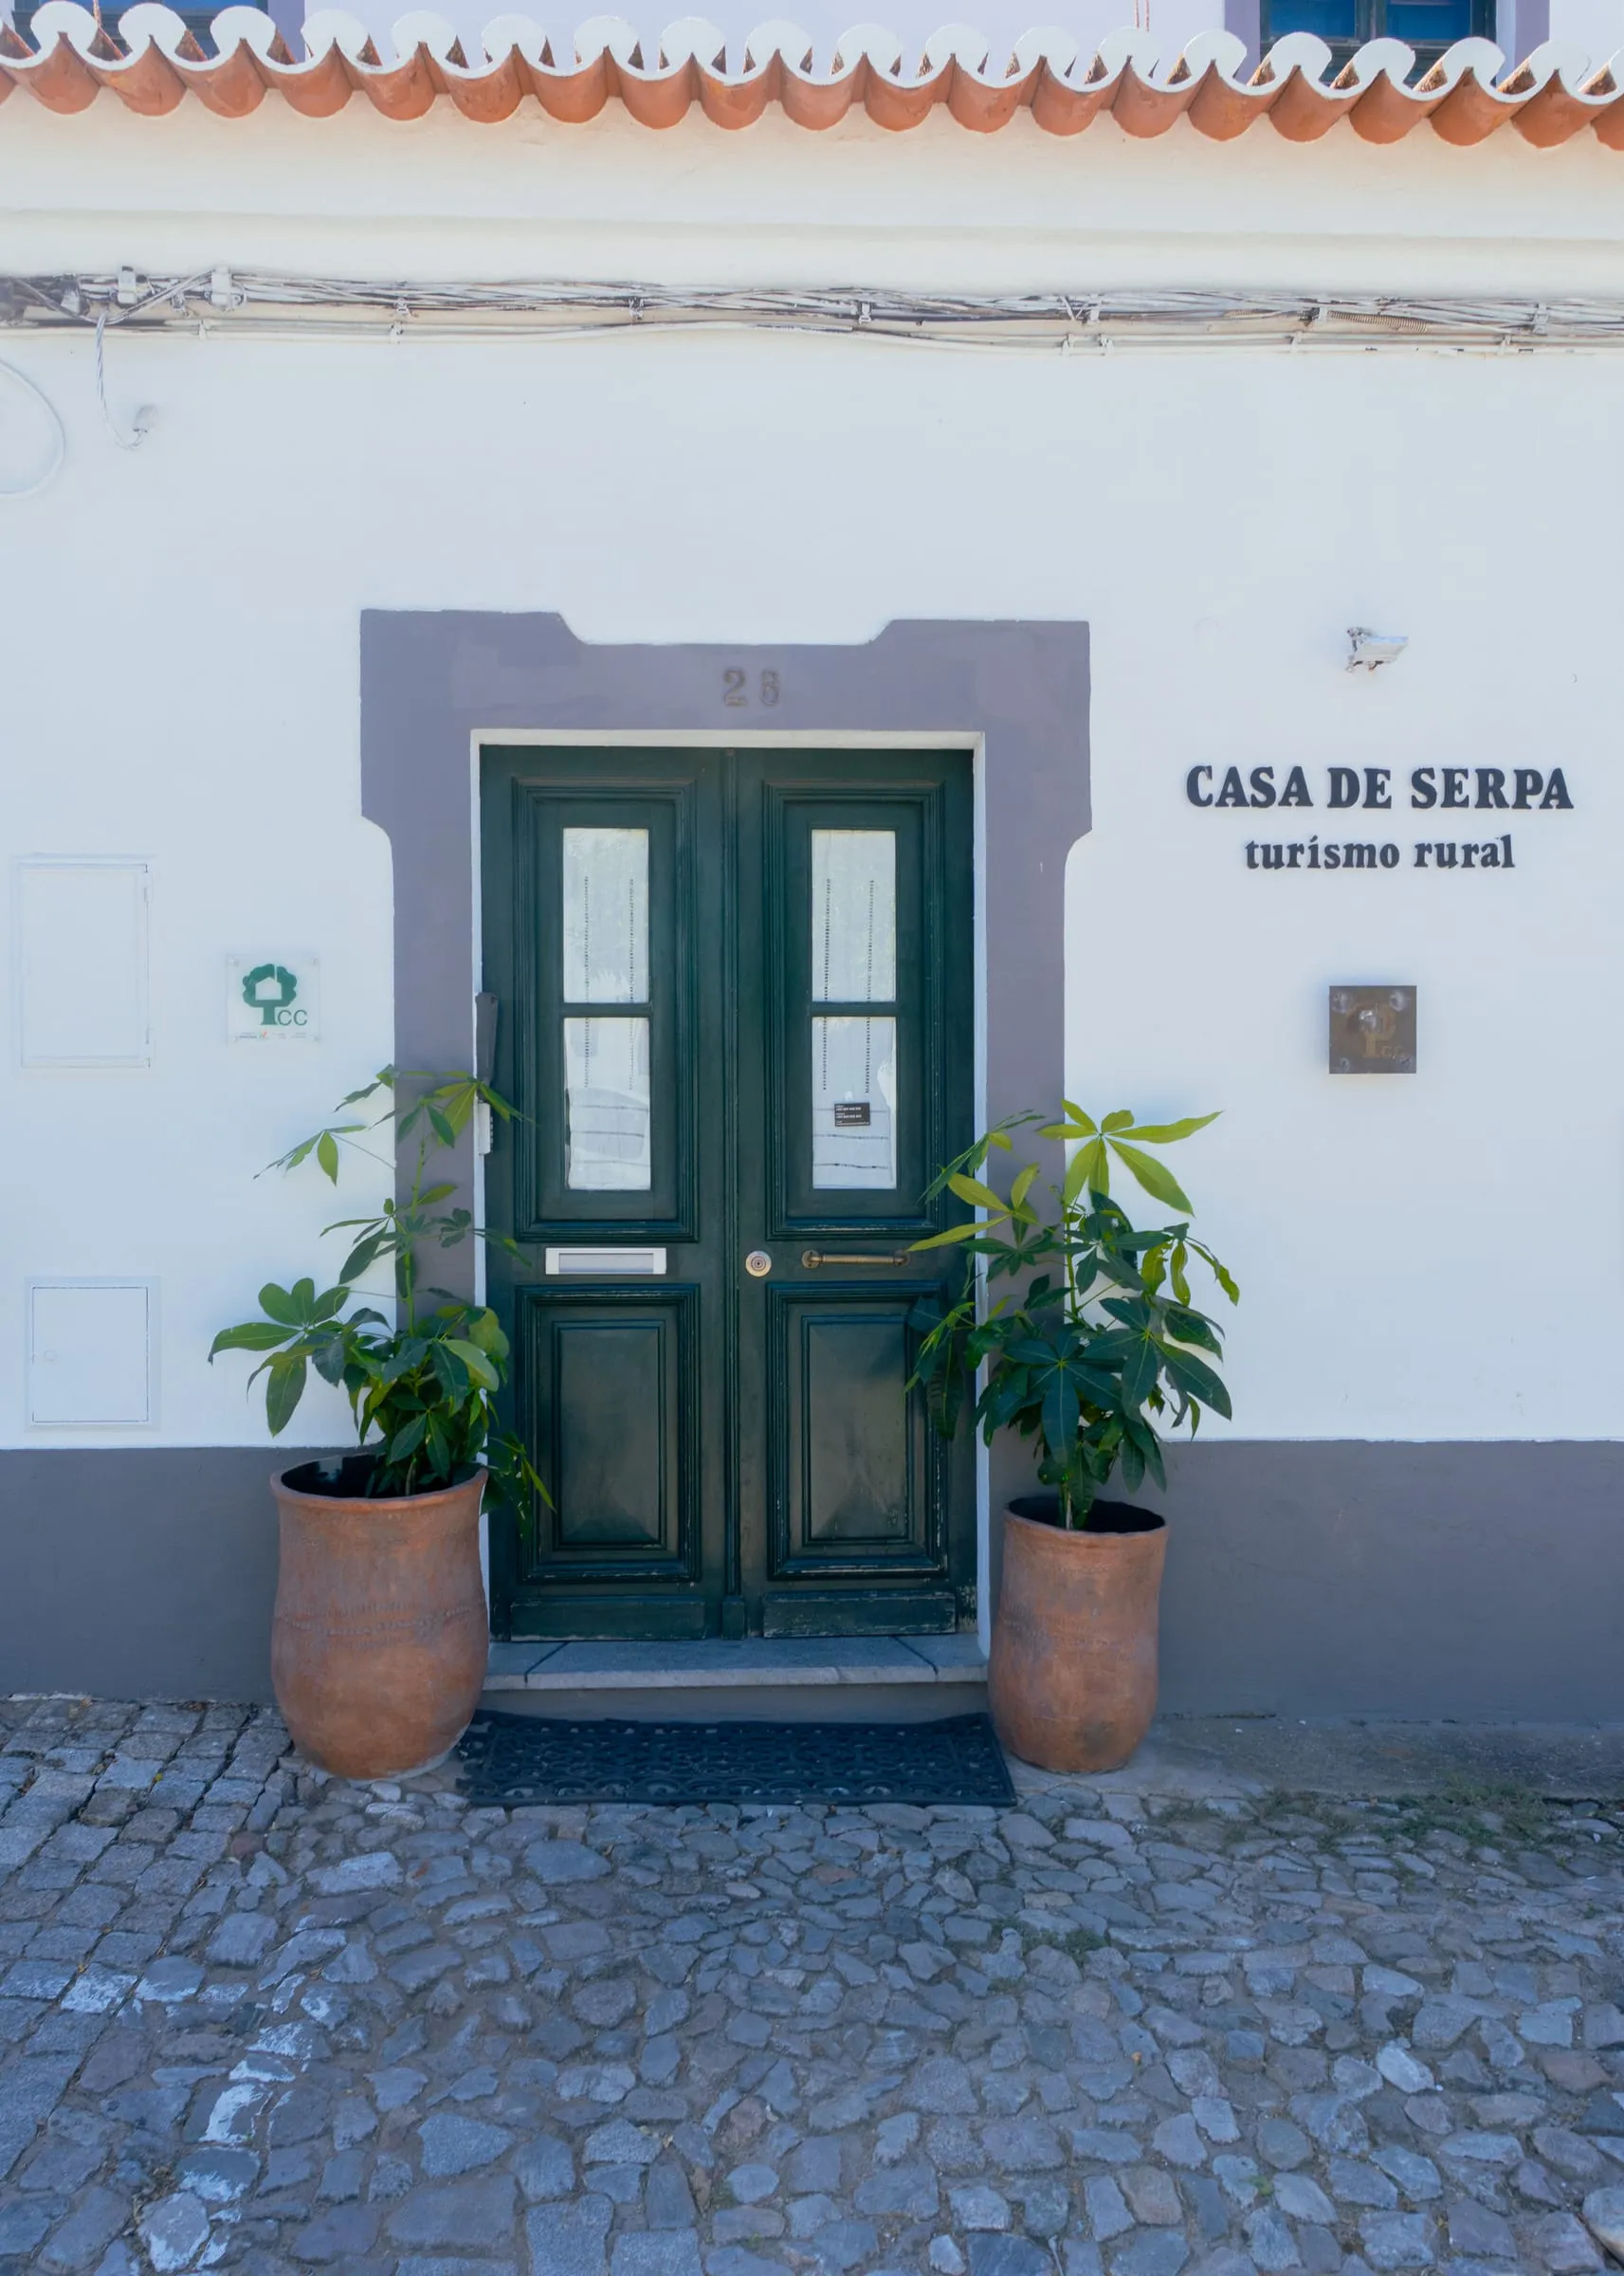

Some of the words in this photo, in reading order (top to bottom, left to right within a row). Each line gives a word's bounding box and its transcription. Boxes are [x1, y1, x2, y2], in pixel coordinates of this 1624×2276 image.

[1186, 765, 1313, 808] CASA
[1327, 767, 1392, 809] DE
[1411, 767, 1574, 809] SERPA
[1245, 835, 1400, 870] turísmo
[1414, 834, 1515, 869] rural
[277, 1009, 308, 1026] CC
